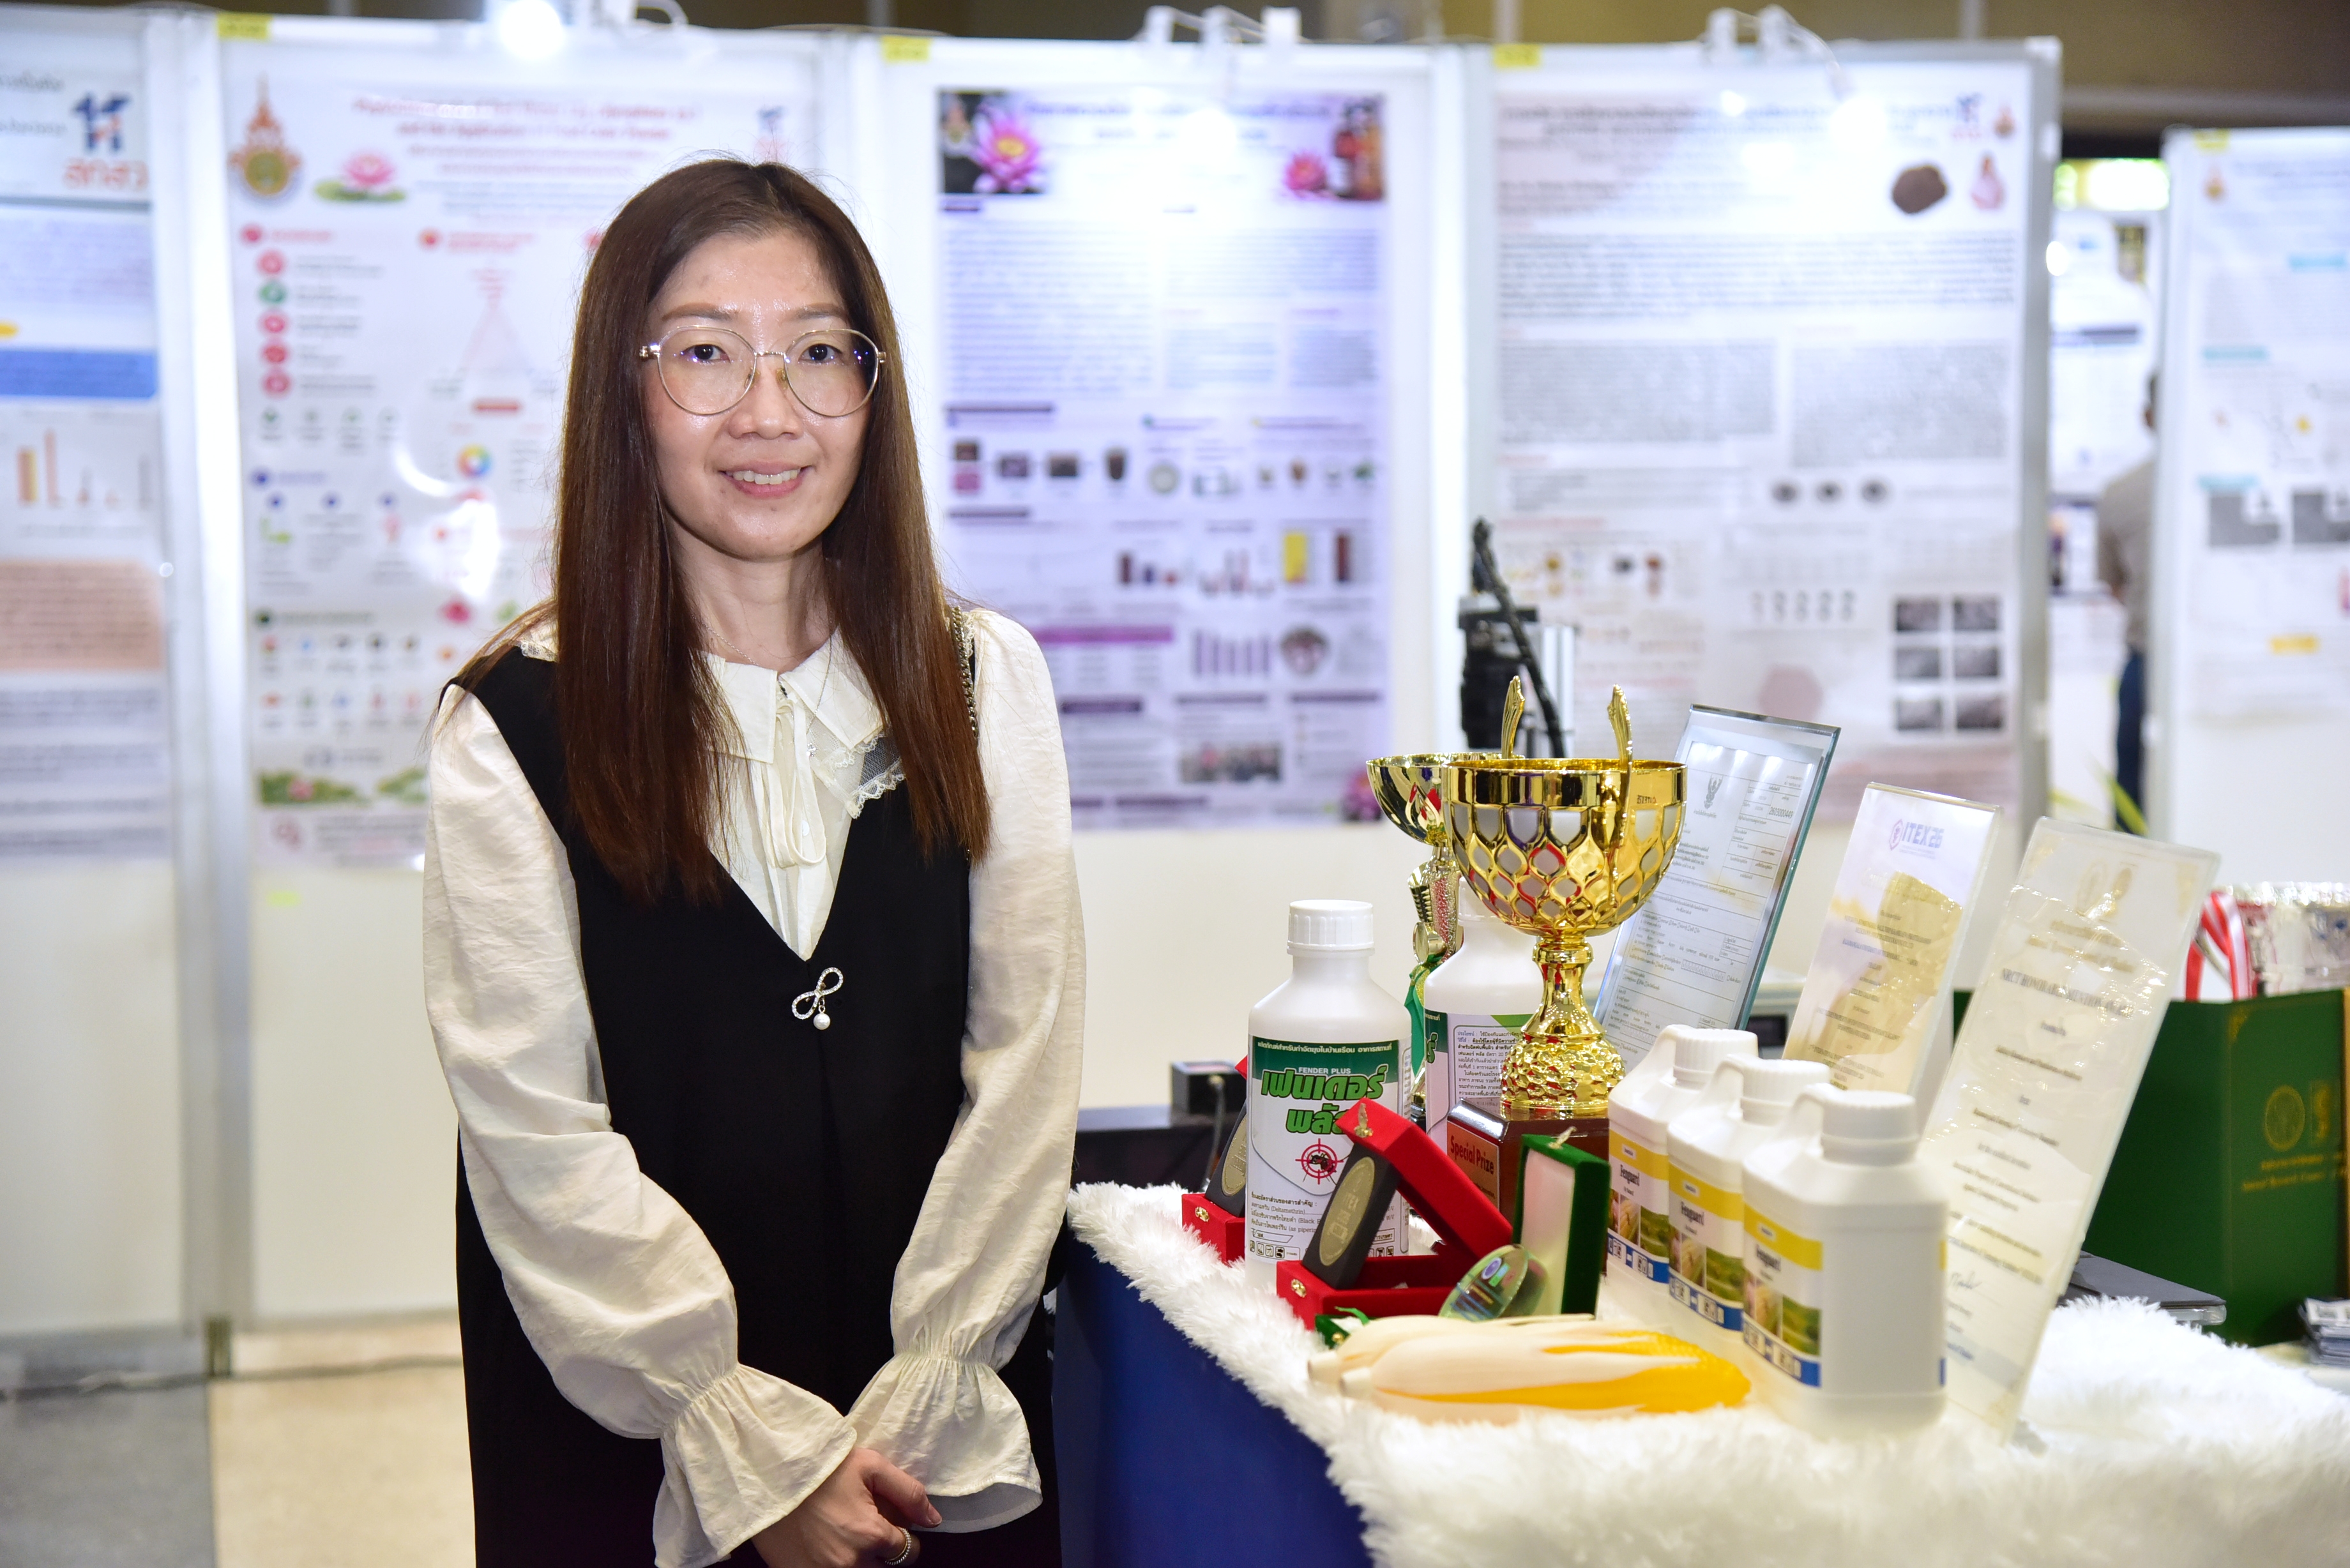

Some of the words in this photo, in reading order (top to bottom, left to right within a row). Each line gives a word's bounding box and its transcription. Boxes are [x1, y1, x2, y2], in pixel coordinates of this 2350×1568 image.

[1261, 1064, 1388, 1101] เฟนเดอร์
[1451, 1135, 1475, 1165] Special
[1476, 1149, 1494, 1175] Prize
